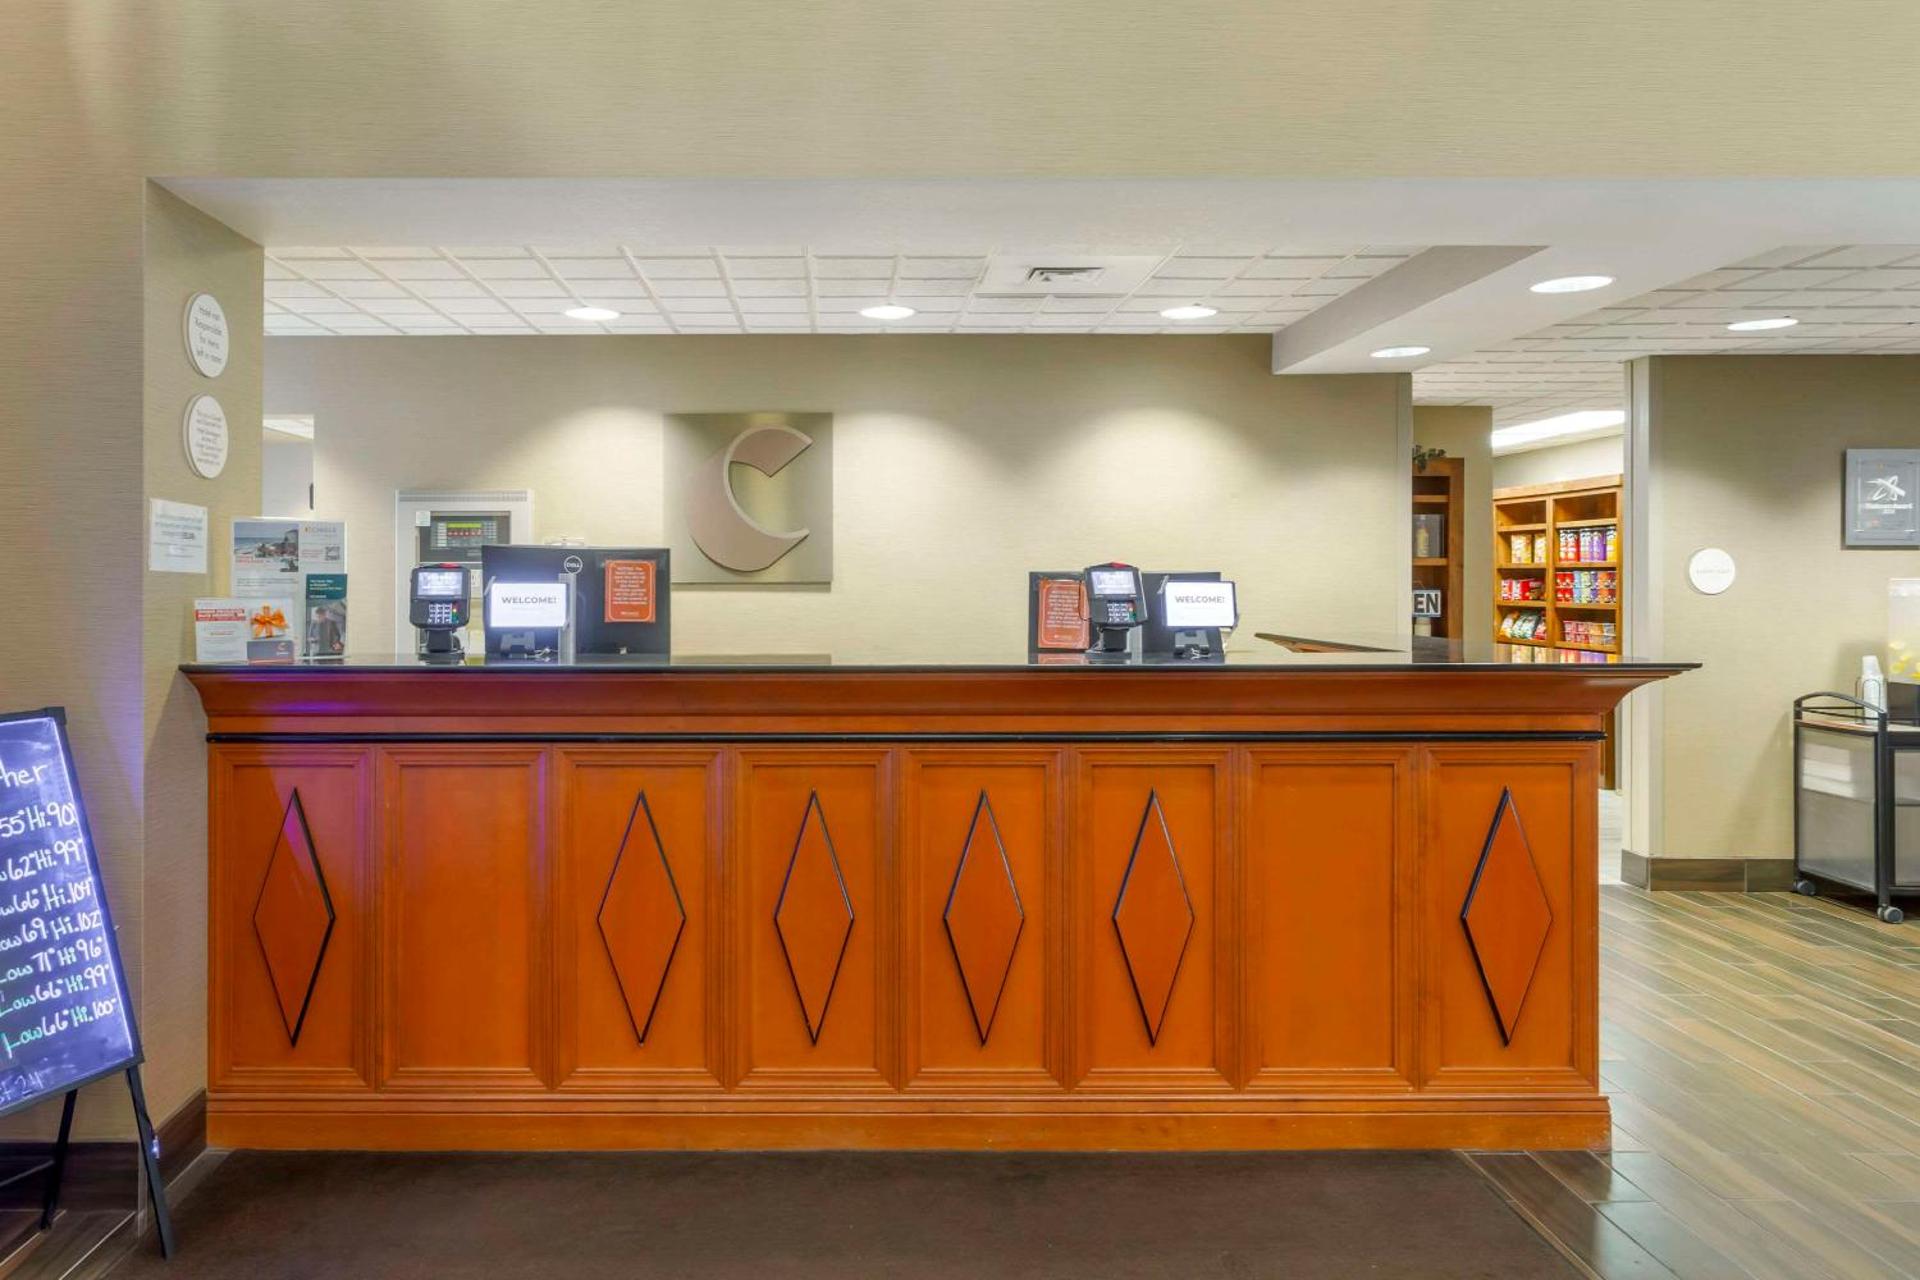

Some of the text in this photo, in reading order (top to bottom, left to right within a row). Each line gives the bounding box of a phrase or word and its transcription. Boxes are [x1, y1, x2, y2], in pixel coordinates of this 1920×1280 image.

[501, 596, 557, 605] WELCOME!
[1174, 595, 1226, 604] WELCOME!
[0, 935, 23, 952] ow
